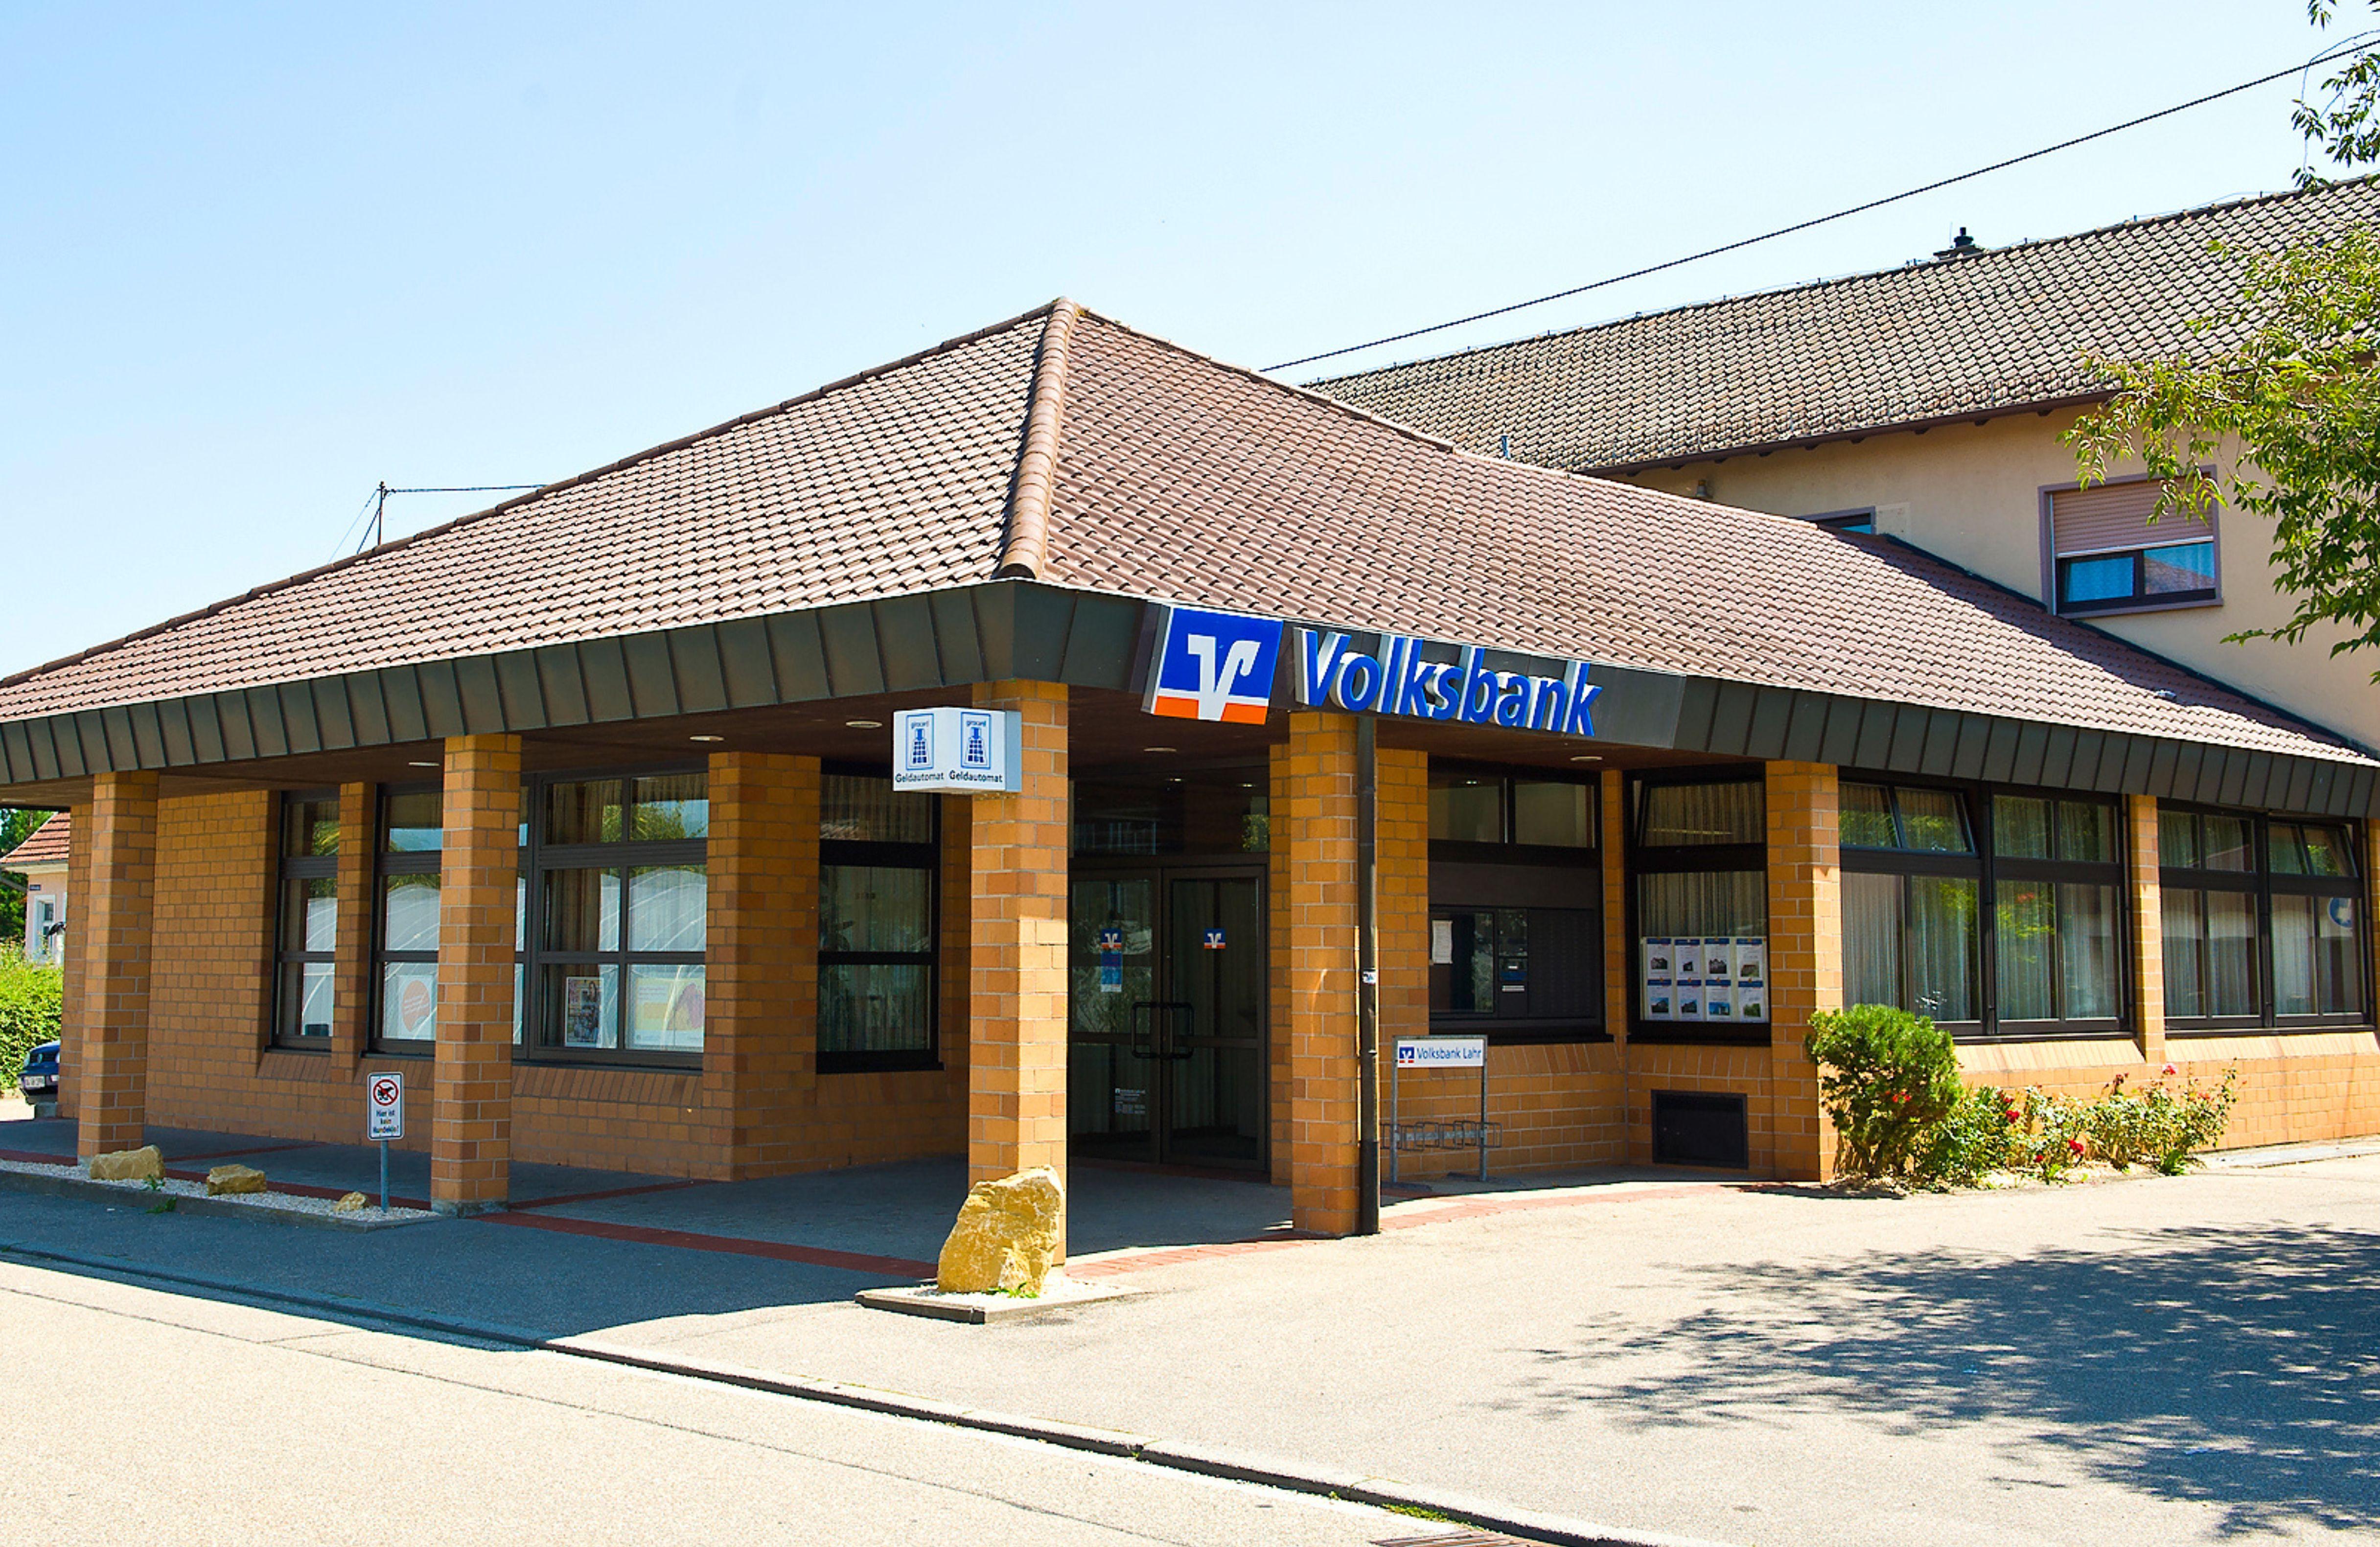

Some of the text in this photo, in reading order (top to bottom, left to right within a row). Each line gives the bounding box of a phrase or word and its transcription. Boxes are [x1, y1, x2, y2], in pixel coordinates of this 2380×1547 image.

[1294, 628, 1602, 737] Volksbank
[895, 772, 944, 783] Geldautomat
[949, 770, 1003, 783] Geldautomat
[1417, 1047, 1481, 1059] Volksbank Lahr
